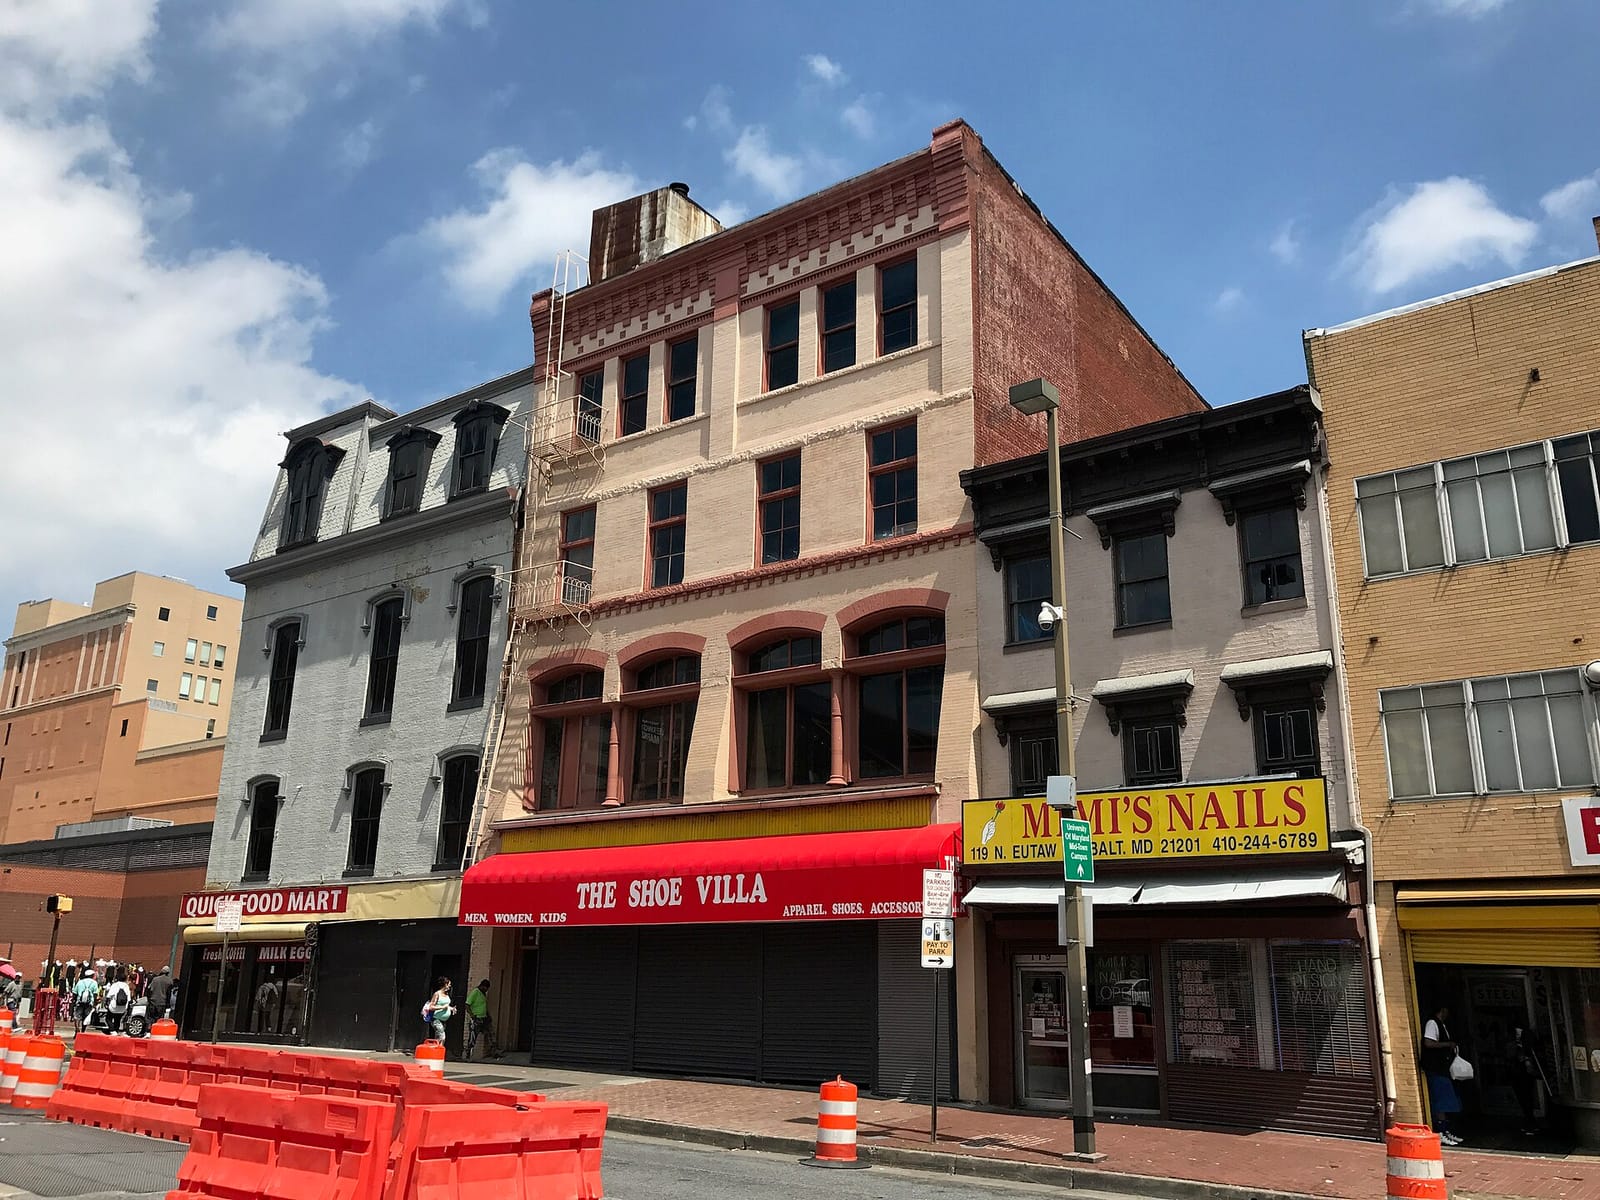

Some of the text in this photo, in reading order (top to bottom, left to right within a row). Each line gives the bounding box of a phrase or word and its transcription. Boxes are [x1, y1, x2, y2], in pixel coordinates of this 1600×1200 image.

[1166, 785, 1307, 832] NAILS
[1066, 823, 1087, 834] University
[1072, 833, 1090, 843] Maryland
[971, 832, 1317, 860] 119 N. EUTAW BALT. MD 21201 410-244-6789
[1069, 842, 1088, 851] Mid-Town
[1071, 852, 1088, 861] Campus
[577, 873, 767, 909] THE SHOE VILLA
[239, 892, 283, 913] FOOD
[287, 889, 342, 911] MART
[783, 901, 923, 916] APPAREL. SHOES. ACCESSOR
[464, 912, 567, 923] MEN. WOMEN. KIDS
[259, 947, 288, 960] MILK
[1297, 958, 1336, 973] HAND
